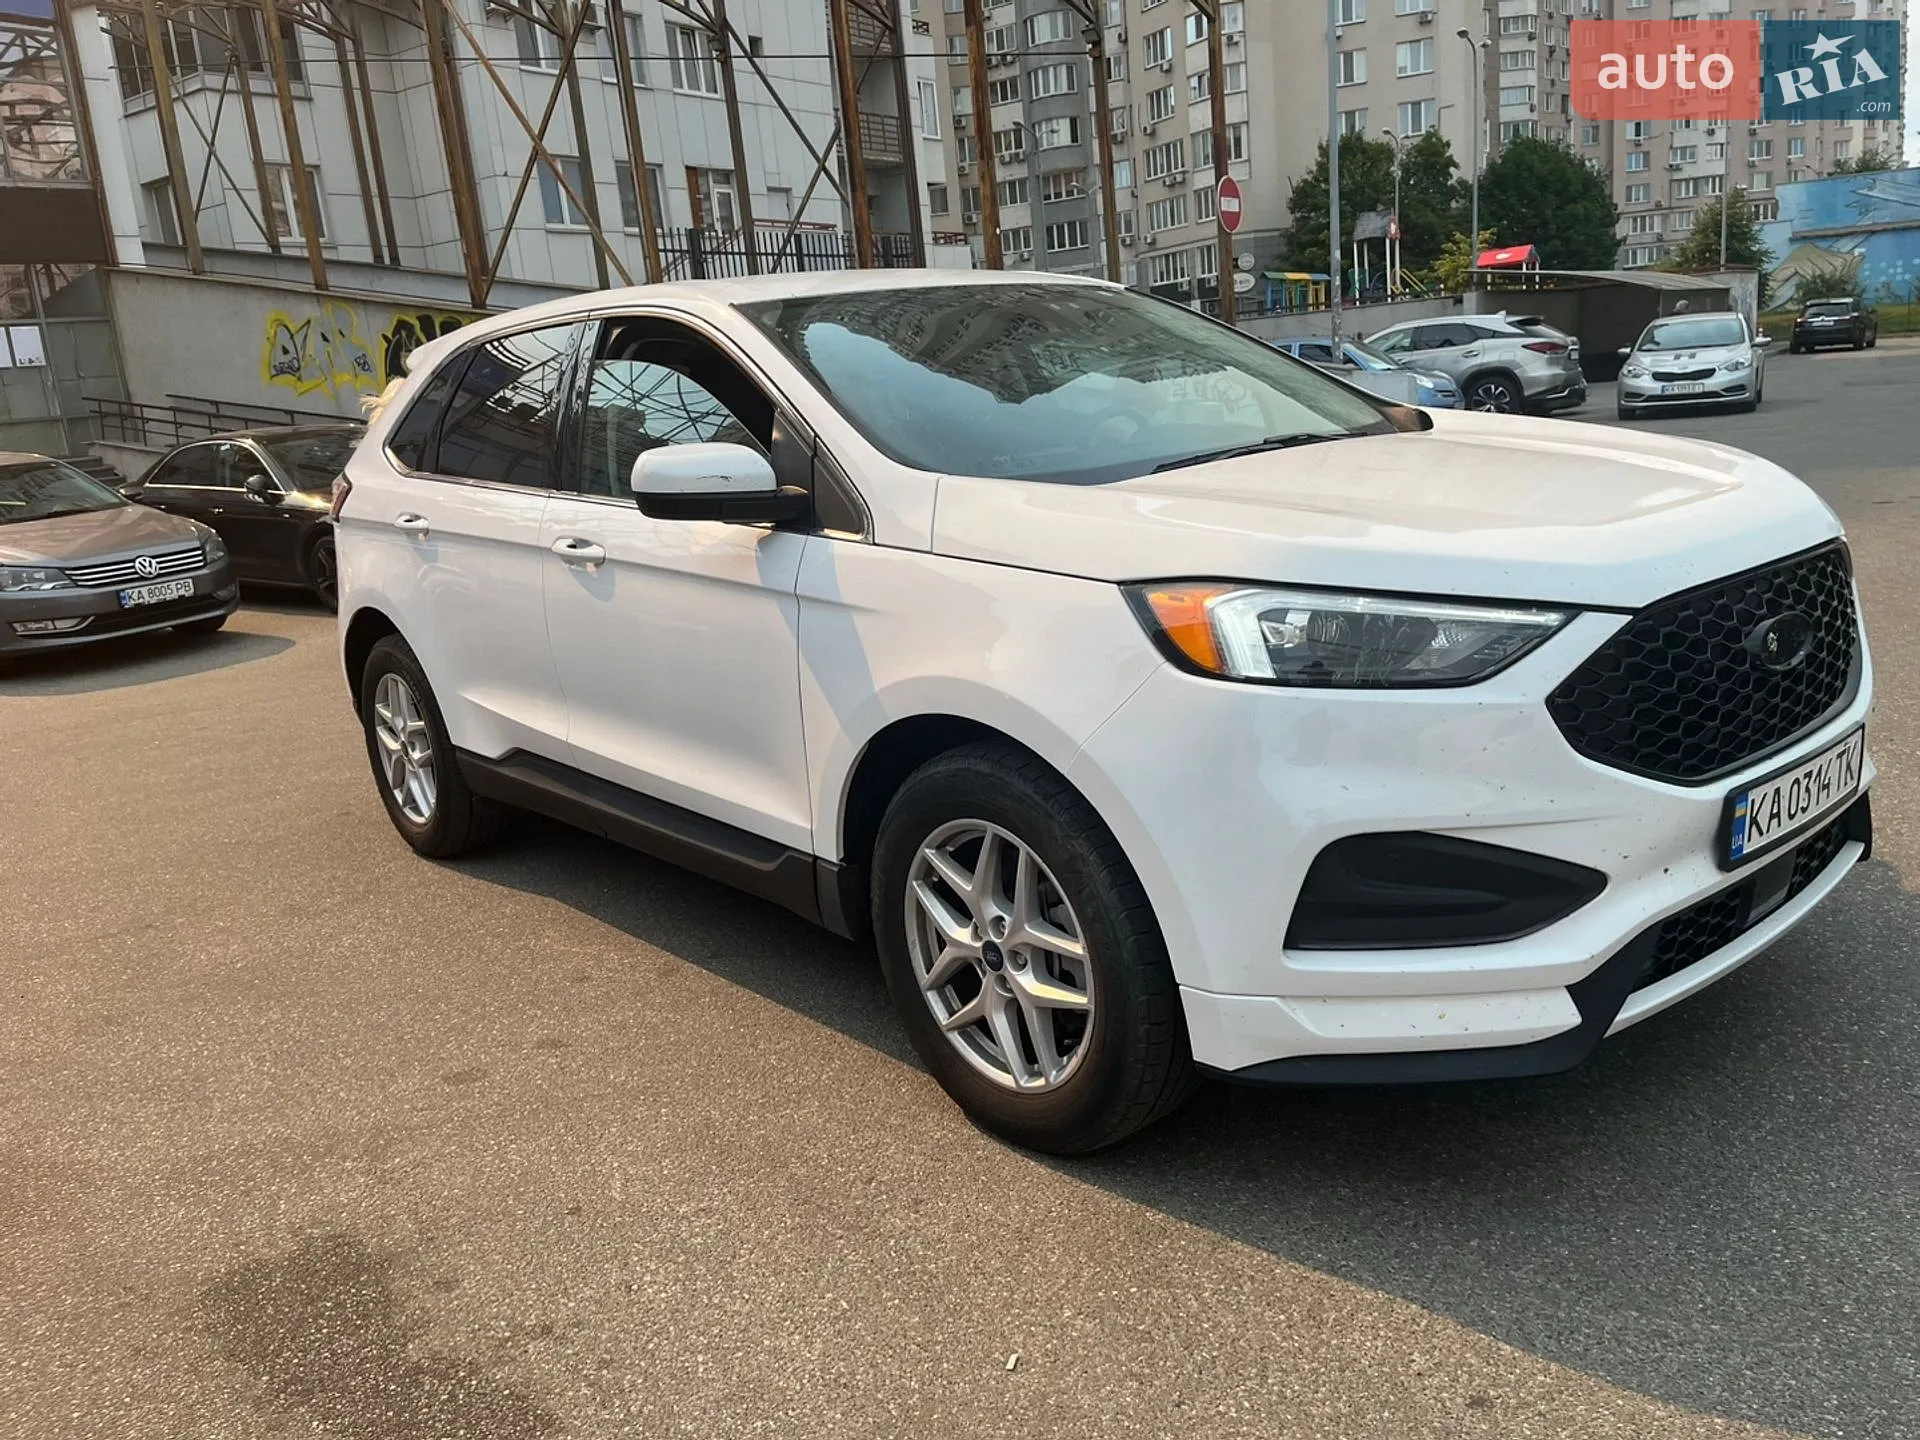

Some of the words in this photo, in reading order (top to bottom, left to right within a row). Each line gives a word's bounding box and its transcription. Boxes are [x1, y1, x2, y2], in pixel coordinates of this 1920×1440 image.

[128, 590, 145, 603] KA
[147, 584, 173, 599] 8005
[175, 581, 192, 593] PB
[1747, 786, 1782, 842] KA
[1787, 757, 1832, 821] 0314
[1836, 740, 1858, 793] TK
[1732, 833, 1743, 849] UA
